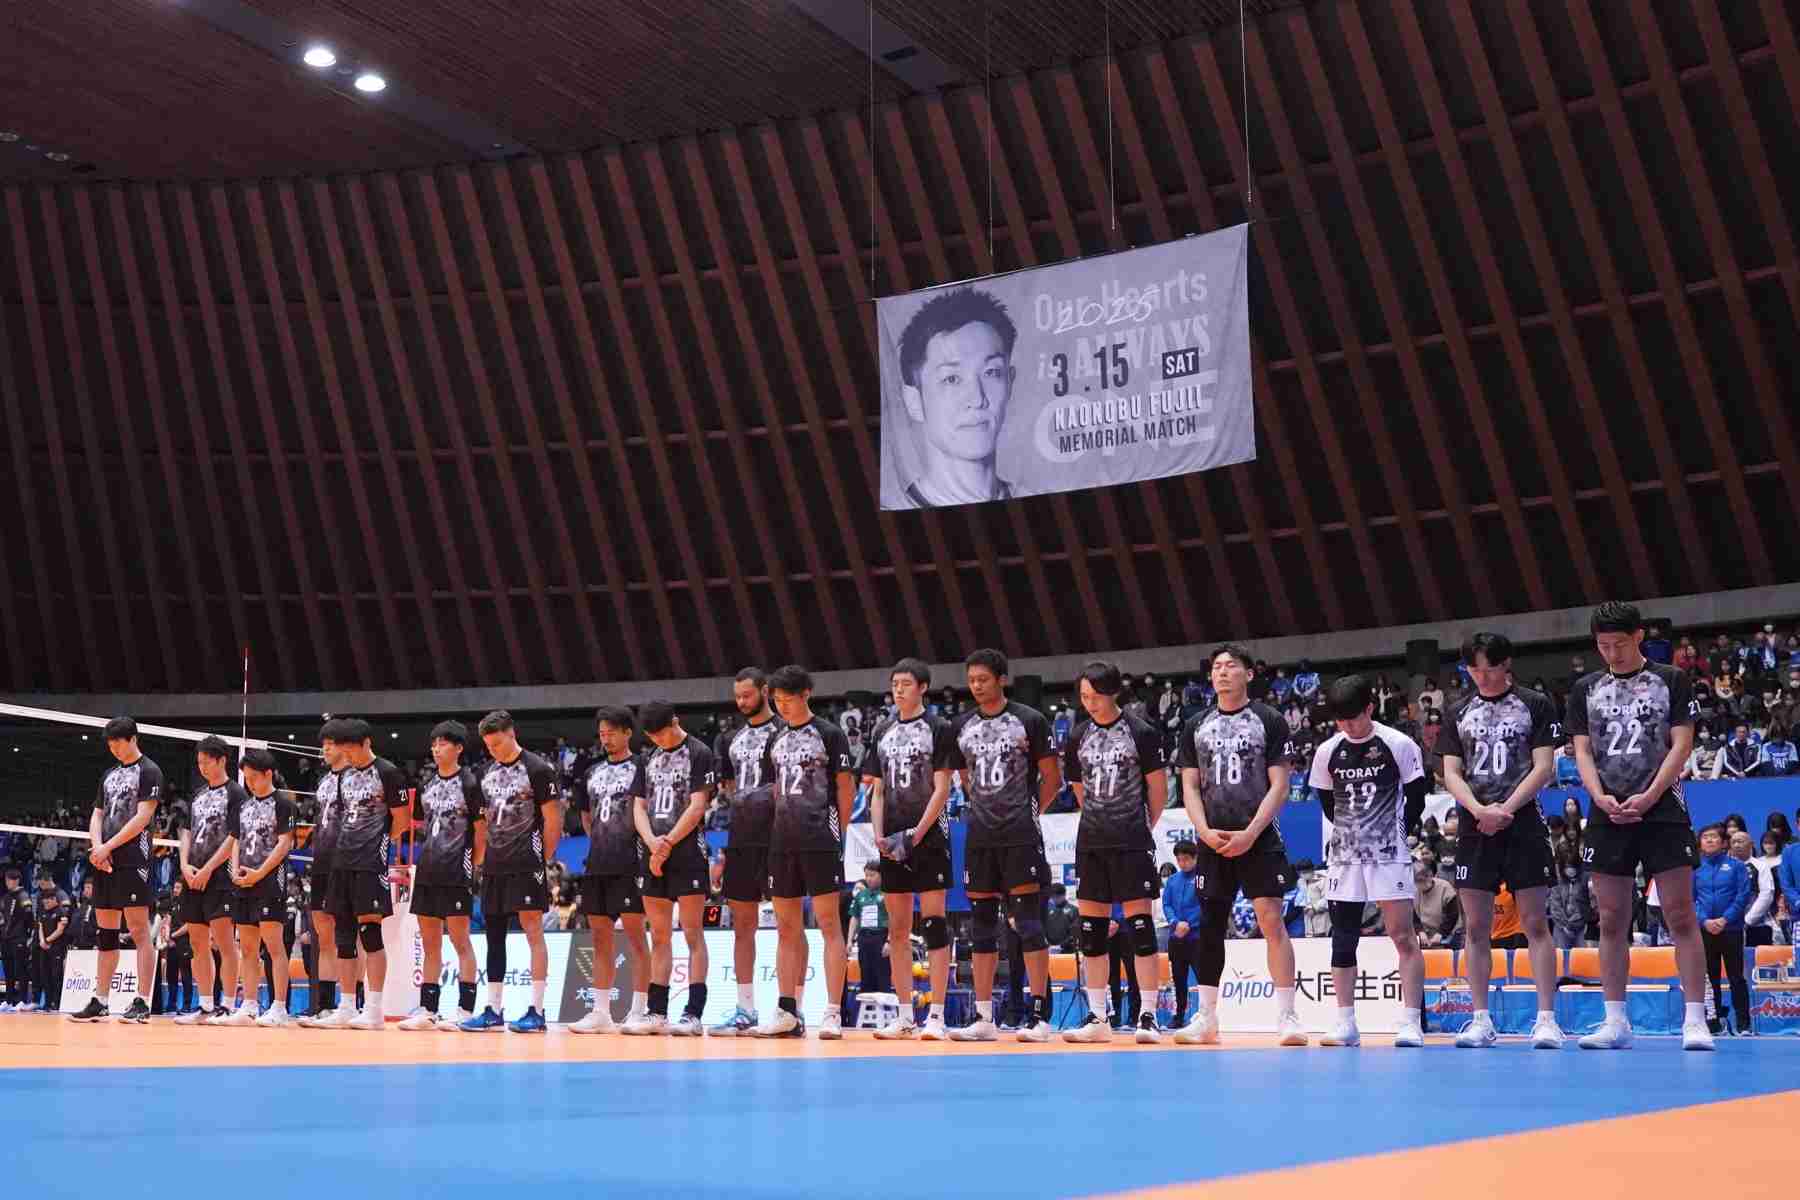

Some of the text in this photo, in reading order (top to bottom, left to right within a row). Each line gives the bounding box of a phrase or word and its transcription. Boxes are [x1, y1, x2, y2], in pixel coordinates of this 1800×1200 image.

[1053, 288, 1160, 335] 2025
[1166, 351, 1195, 376] SAT
[1149, 386, 1201, 418] FUJII
[1059, 414, 1197, 454] MEMORIAL MATCH
[1606, 720, 1643, 756] 22
[977, 757, 1004, 787] 16
[1212, 752, 1241, 785] 18
[1474, 741, 1507, 776] 20
[740, 761, 762, 790] 11
[780, 765, 803, 795] 12
[888, 759, 911, 788] 15
[1092, 765, 1119, 797] 17
[601, 796, 611, 823] 8
[655, 785, 674, 813] 10
[1345, 782, 1376, 809] 19
[495, 799, 505, 825] 7
[196, 818, 206, 843] 2
[246, 830, 257, 856] 3
[1222, 982, 1275, 1004] DAIDO
